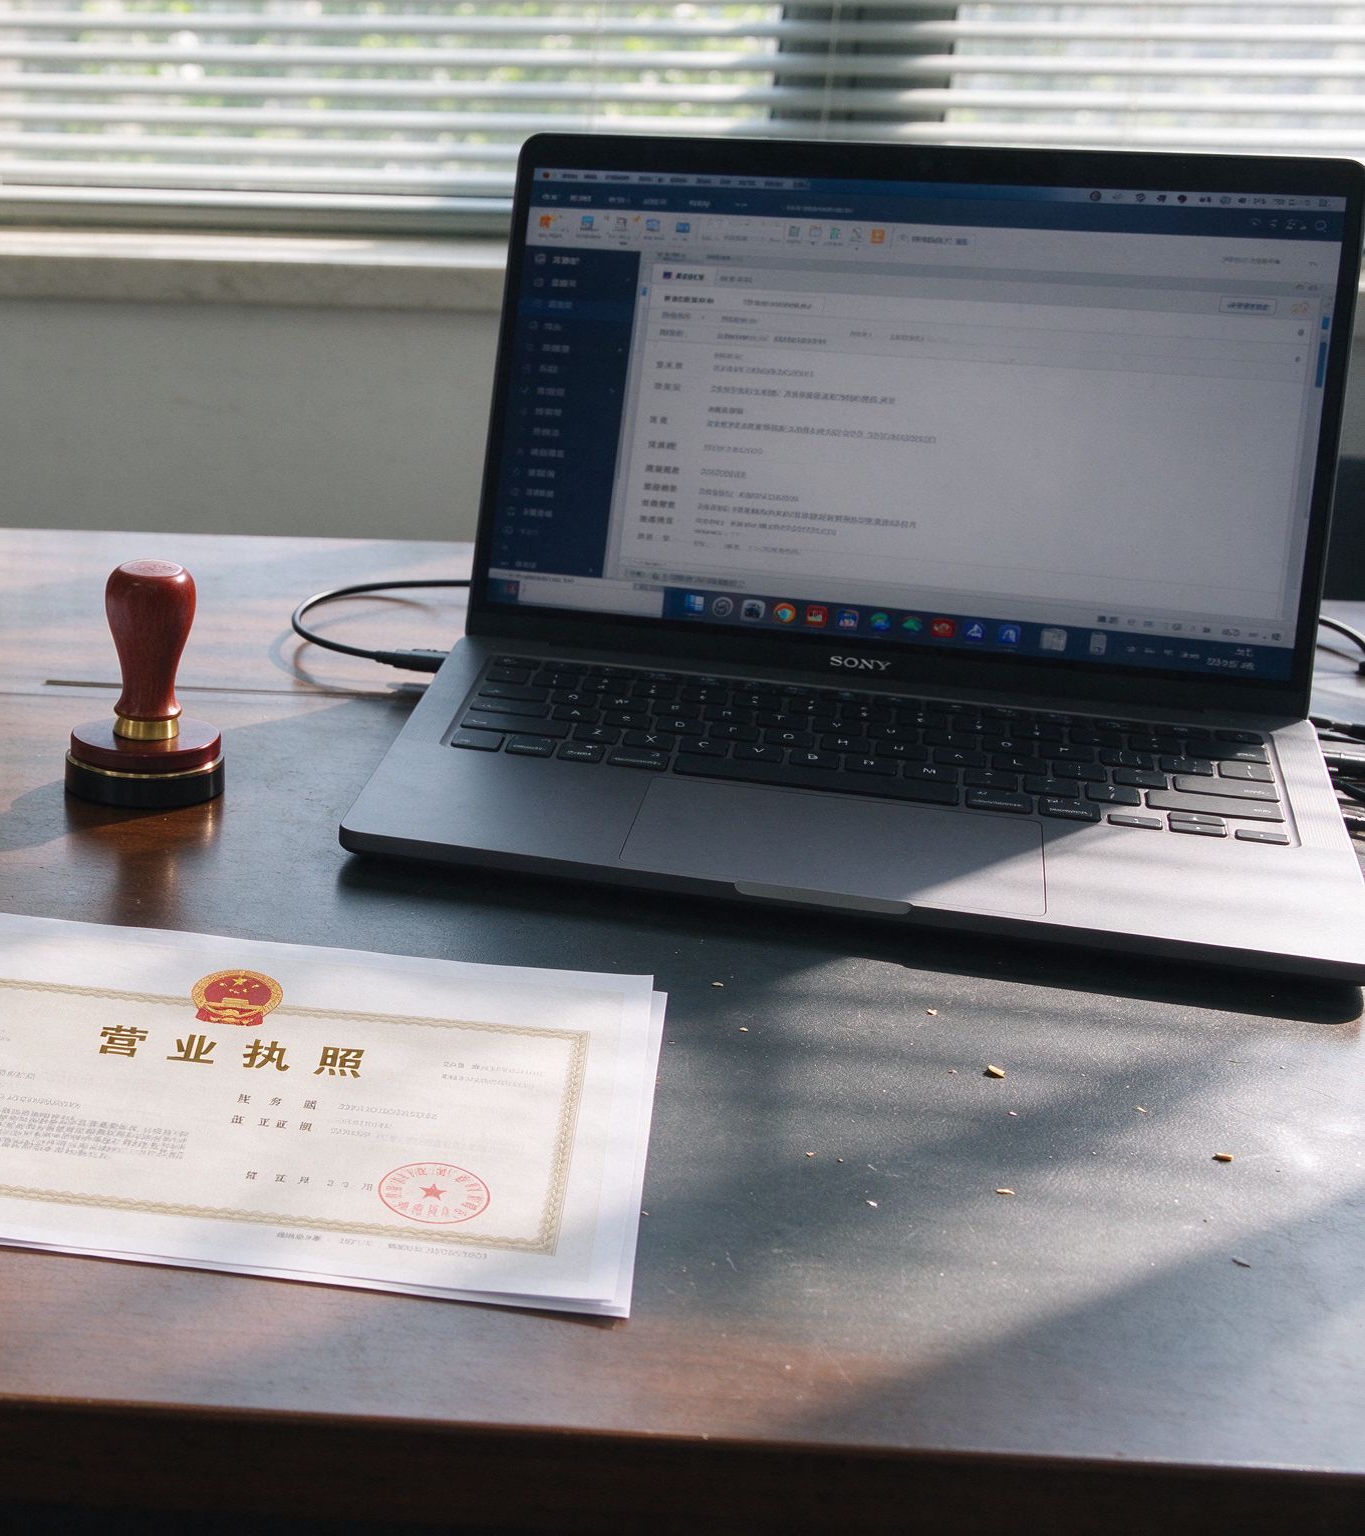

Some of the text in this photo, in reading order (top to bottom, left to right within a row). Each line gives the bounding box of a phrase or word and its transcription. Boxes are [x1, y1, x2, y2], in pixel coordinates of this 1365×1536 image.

[829, 655, 892, 671] SONY
[98, 1024, 366, 1079] 营业执照
